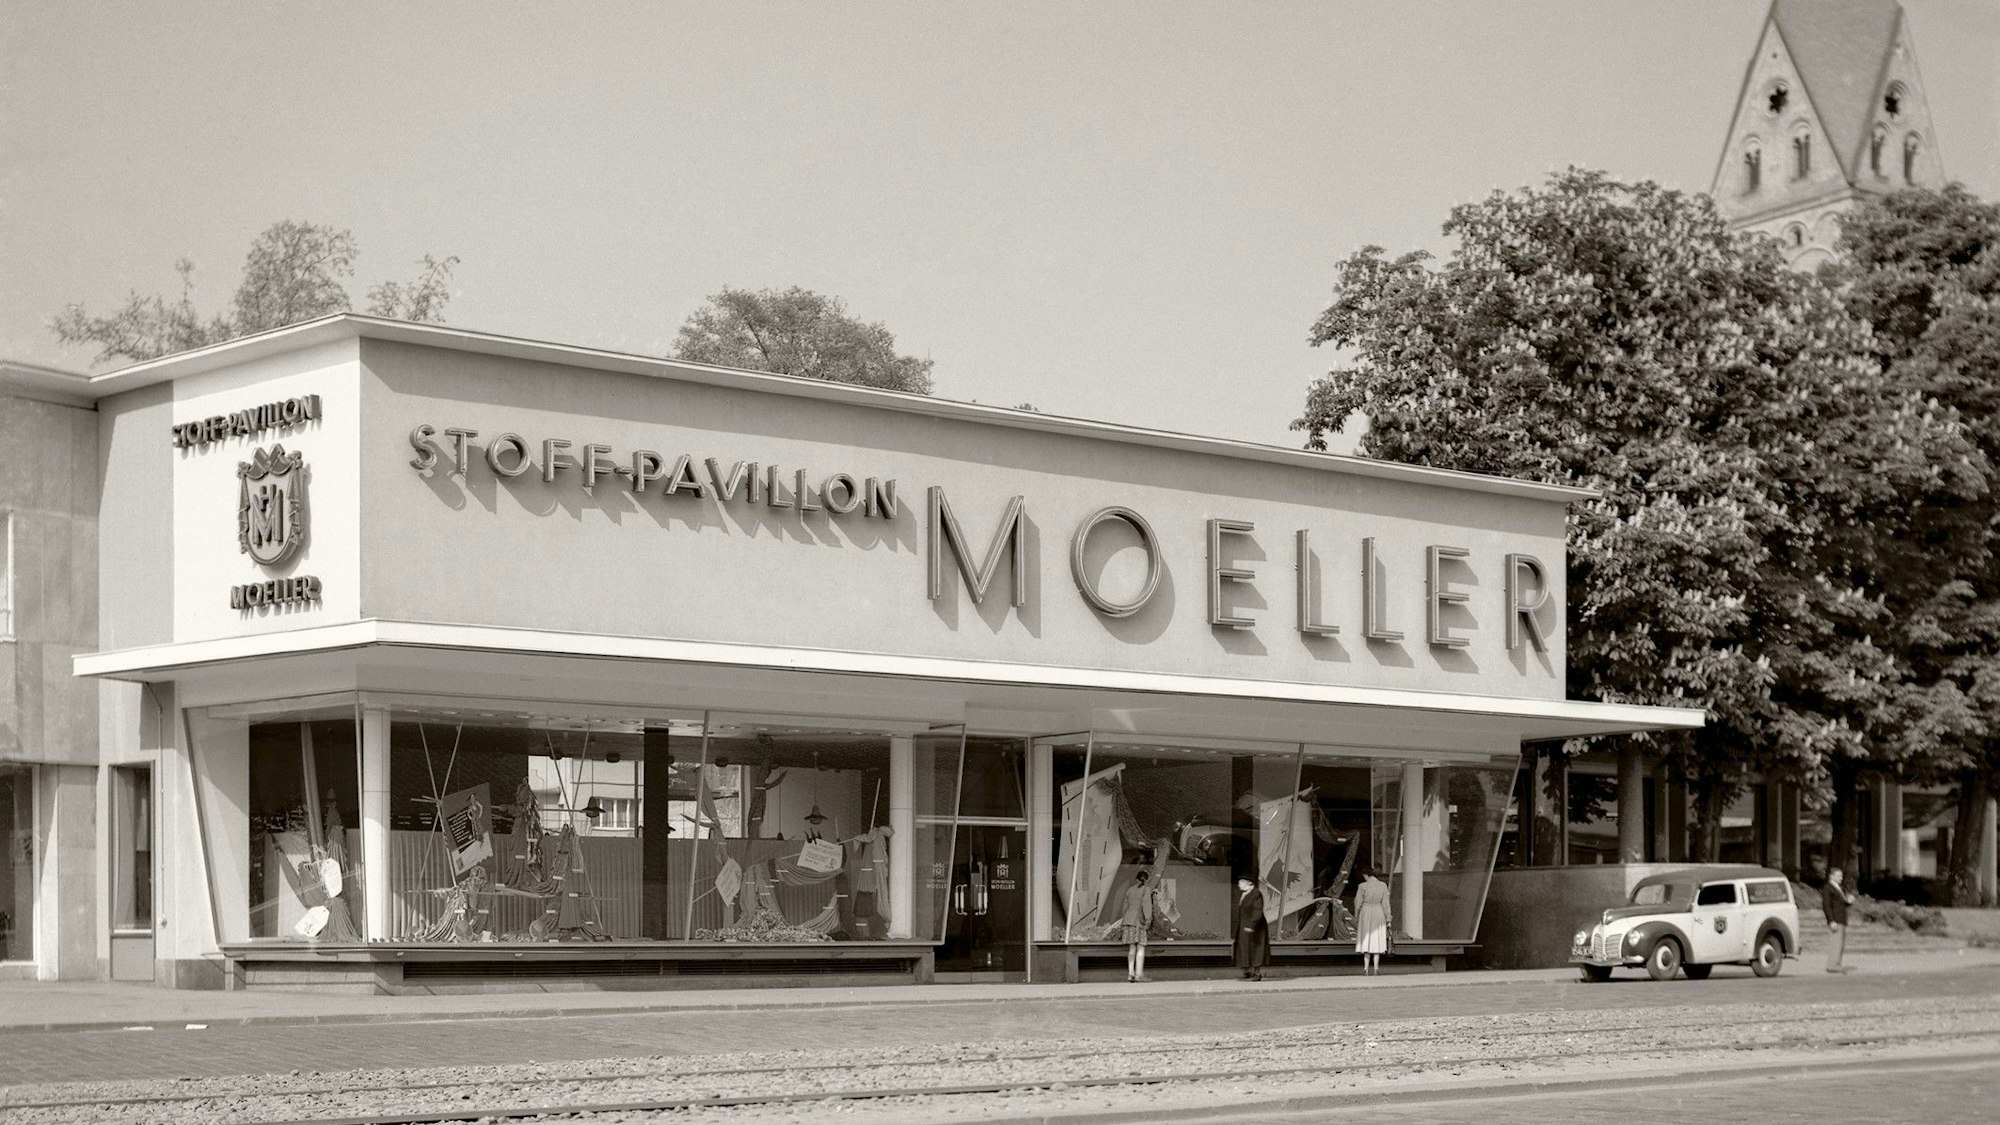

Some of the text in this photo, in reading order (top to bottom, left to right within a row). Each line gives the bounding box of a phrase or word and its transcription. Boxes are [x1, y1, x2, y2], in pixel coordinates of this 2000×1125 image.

[172, 394, 320, 448] STOFF-PAVILLON
[409, 424, 1550, 653] STOFF-PAVILLON MOELLER
[230, 575, 322, 609] MOELLER
